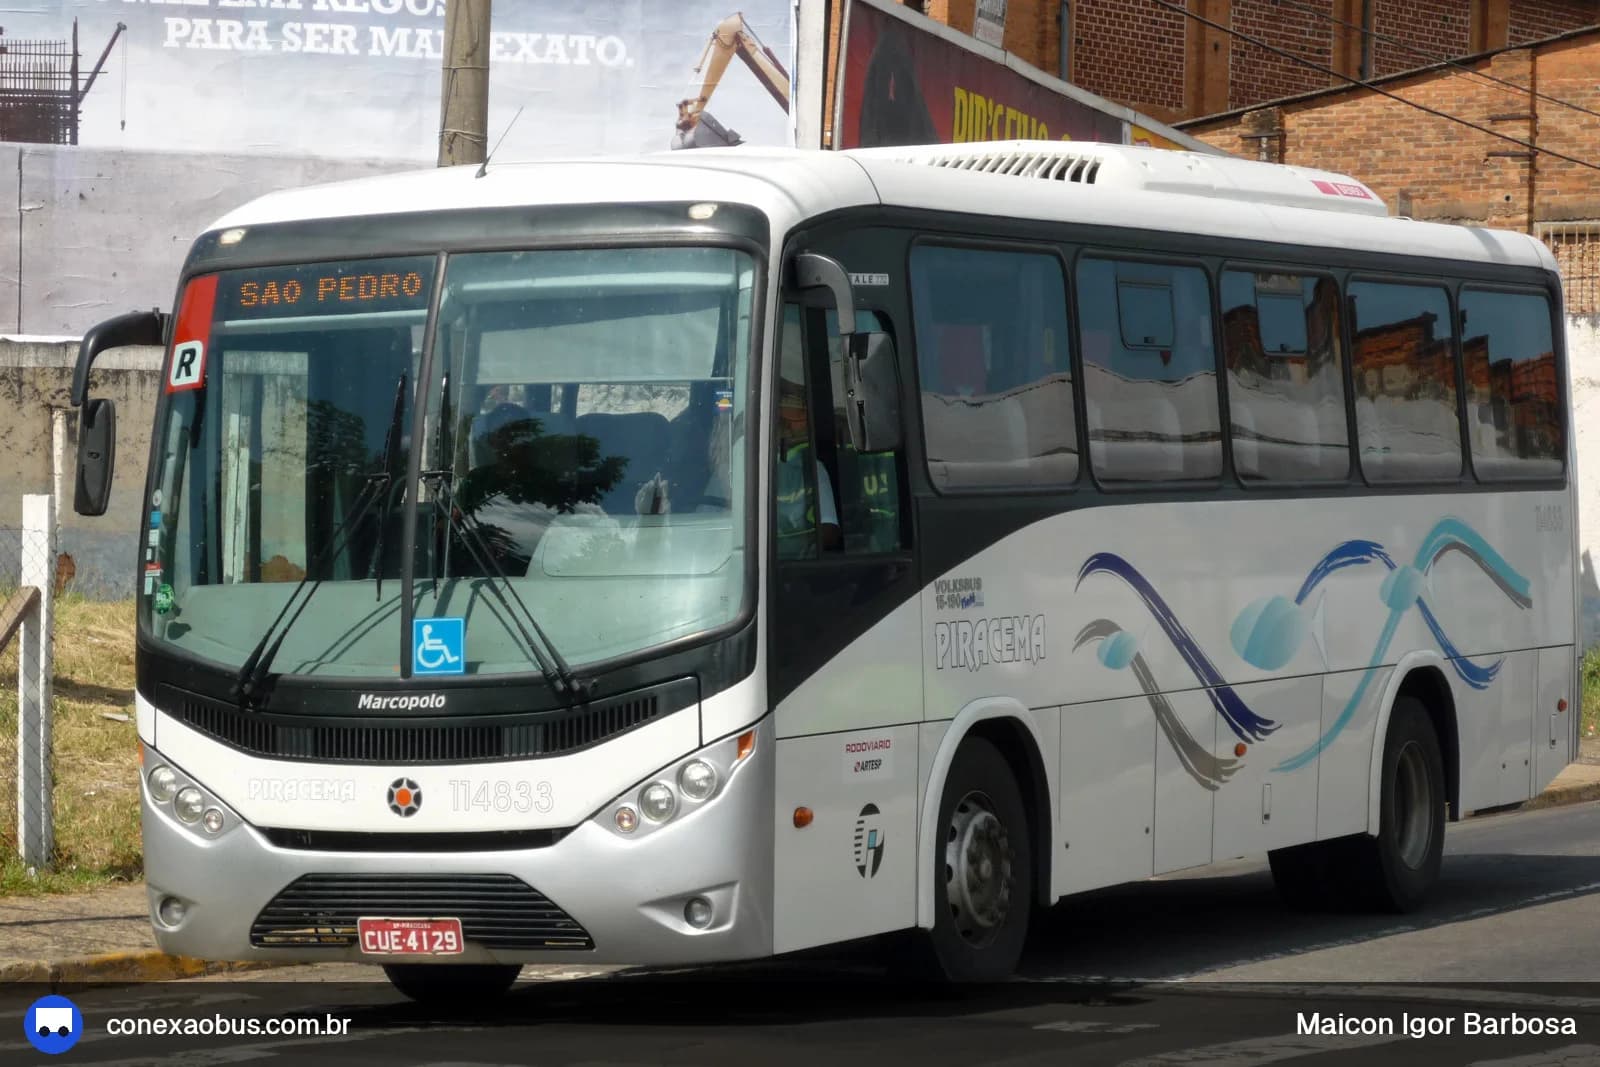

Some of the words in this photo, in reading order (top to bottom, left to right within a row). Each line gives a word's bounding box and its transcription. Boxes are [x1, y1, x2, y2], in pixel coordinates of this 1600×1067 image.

[163, 17, 271, 49] PARA
[281, 22, 360, 55] SER
[367, 25, 445, 58] MA
[488, 31, 635, 66] EXATO.
[239, 278, 302, 307] SAO
[317, 271, 423, 301] PEDRO
[174, 347, 197, 380] R
[934, 577, 982, 594] VOLKSBUS
[935, 613, 1046, 672] PIRACEMA
[357, 692, 447, 711] Marcopolo
[247, 778, 356, 804] PIRACEMA
[448, 779, 554, 814] 114833
